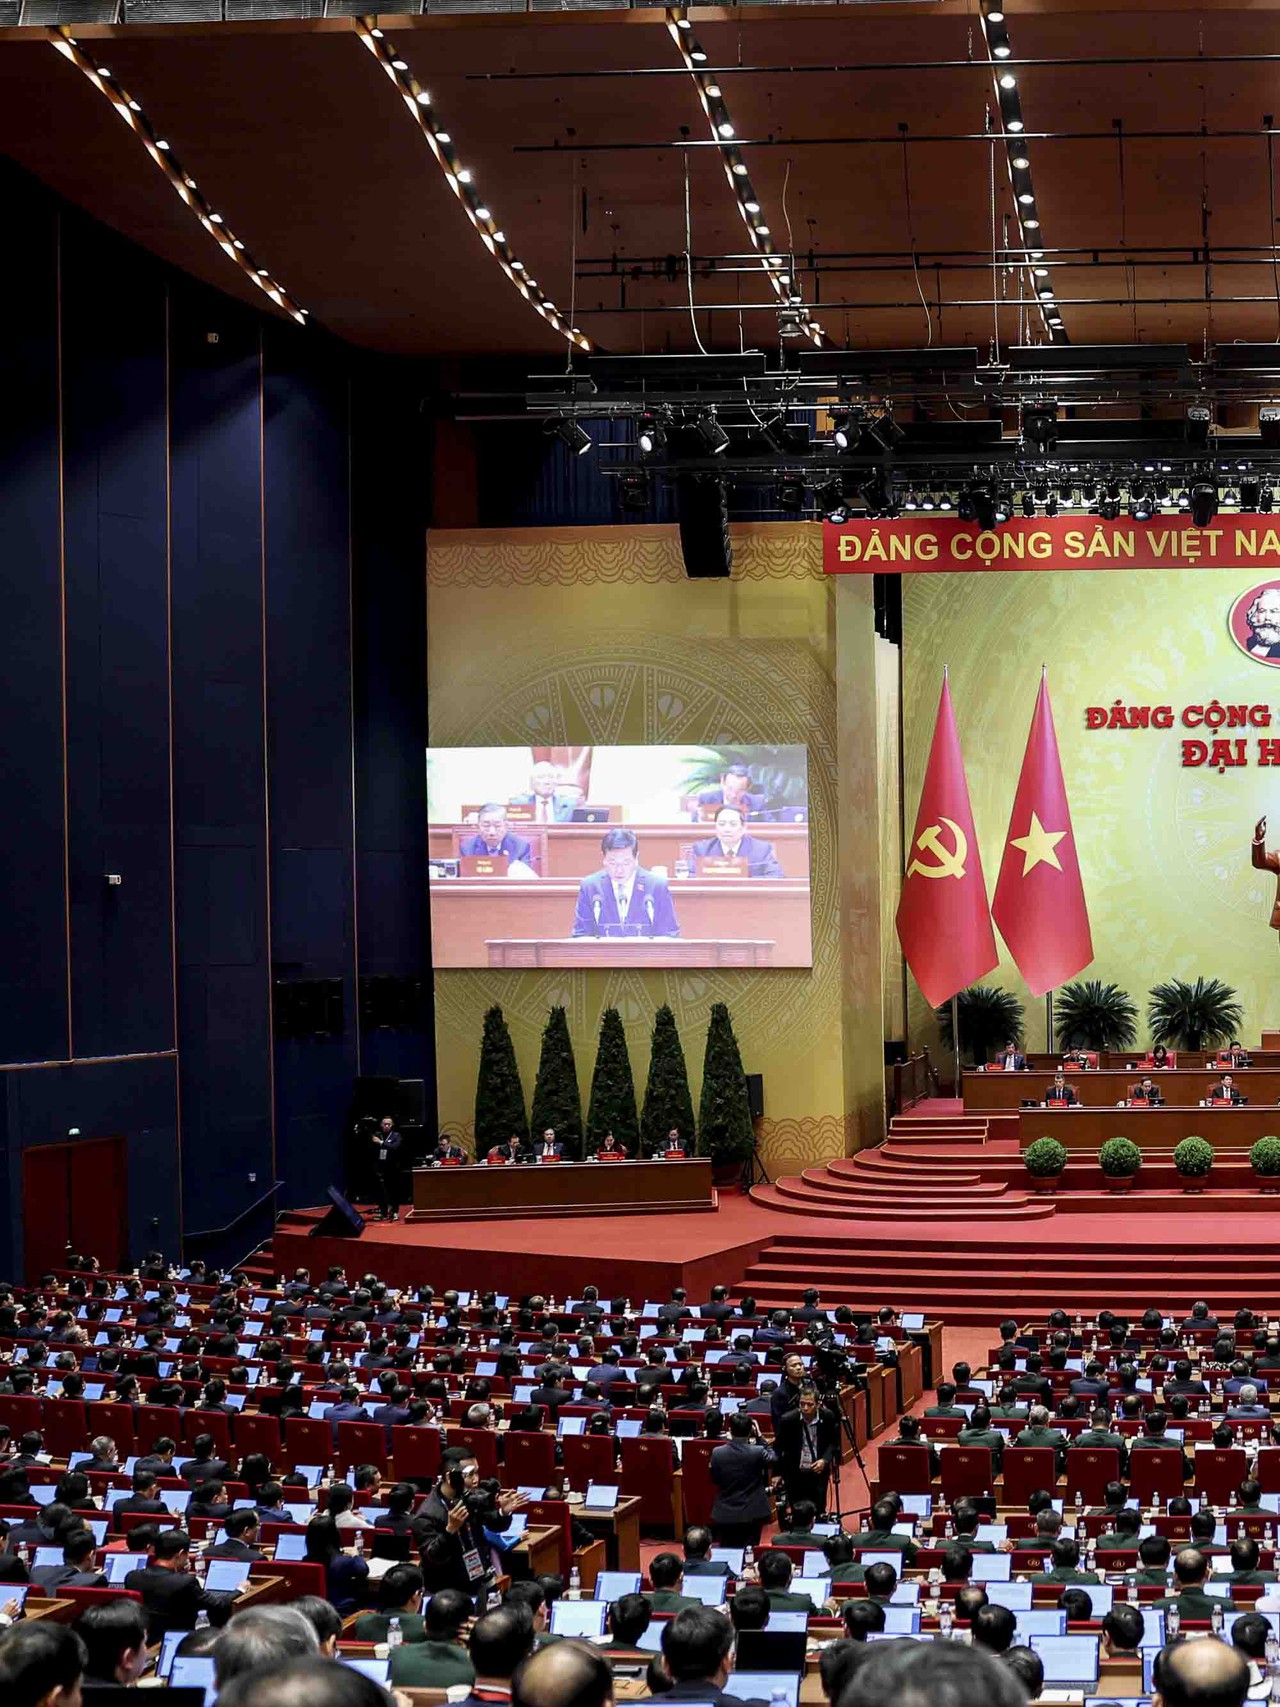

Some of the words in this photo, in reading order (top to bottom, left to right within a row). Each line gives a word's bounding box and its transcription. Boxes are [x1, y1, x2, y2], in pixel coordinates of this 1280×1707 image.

[837, 528, 939, 561] ĐẢNG
[950, 530, 1053, 566] CỘNG
[1063, 524, 1136, 558] SẢN
[1146, 527, 1224, 563] VIỆT
[1086, 698, 1175, 729] ĐẢNG
[1182, 699, 1271, 735] CỘNG
[1181, 739, 1249, 774] ĐẠI
